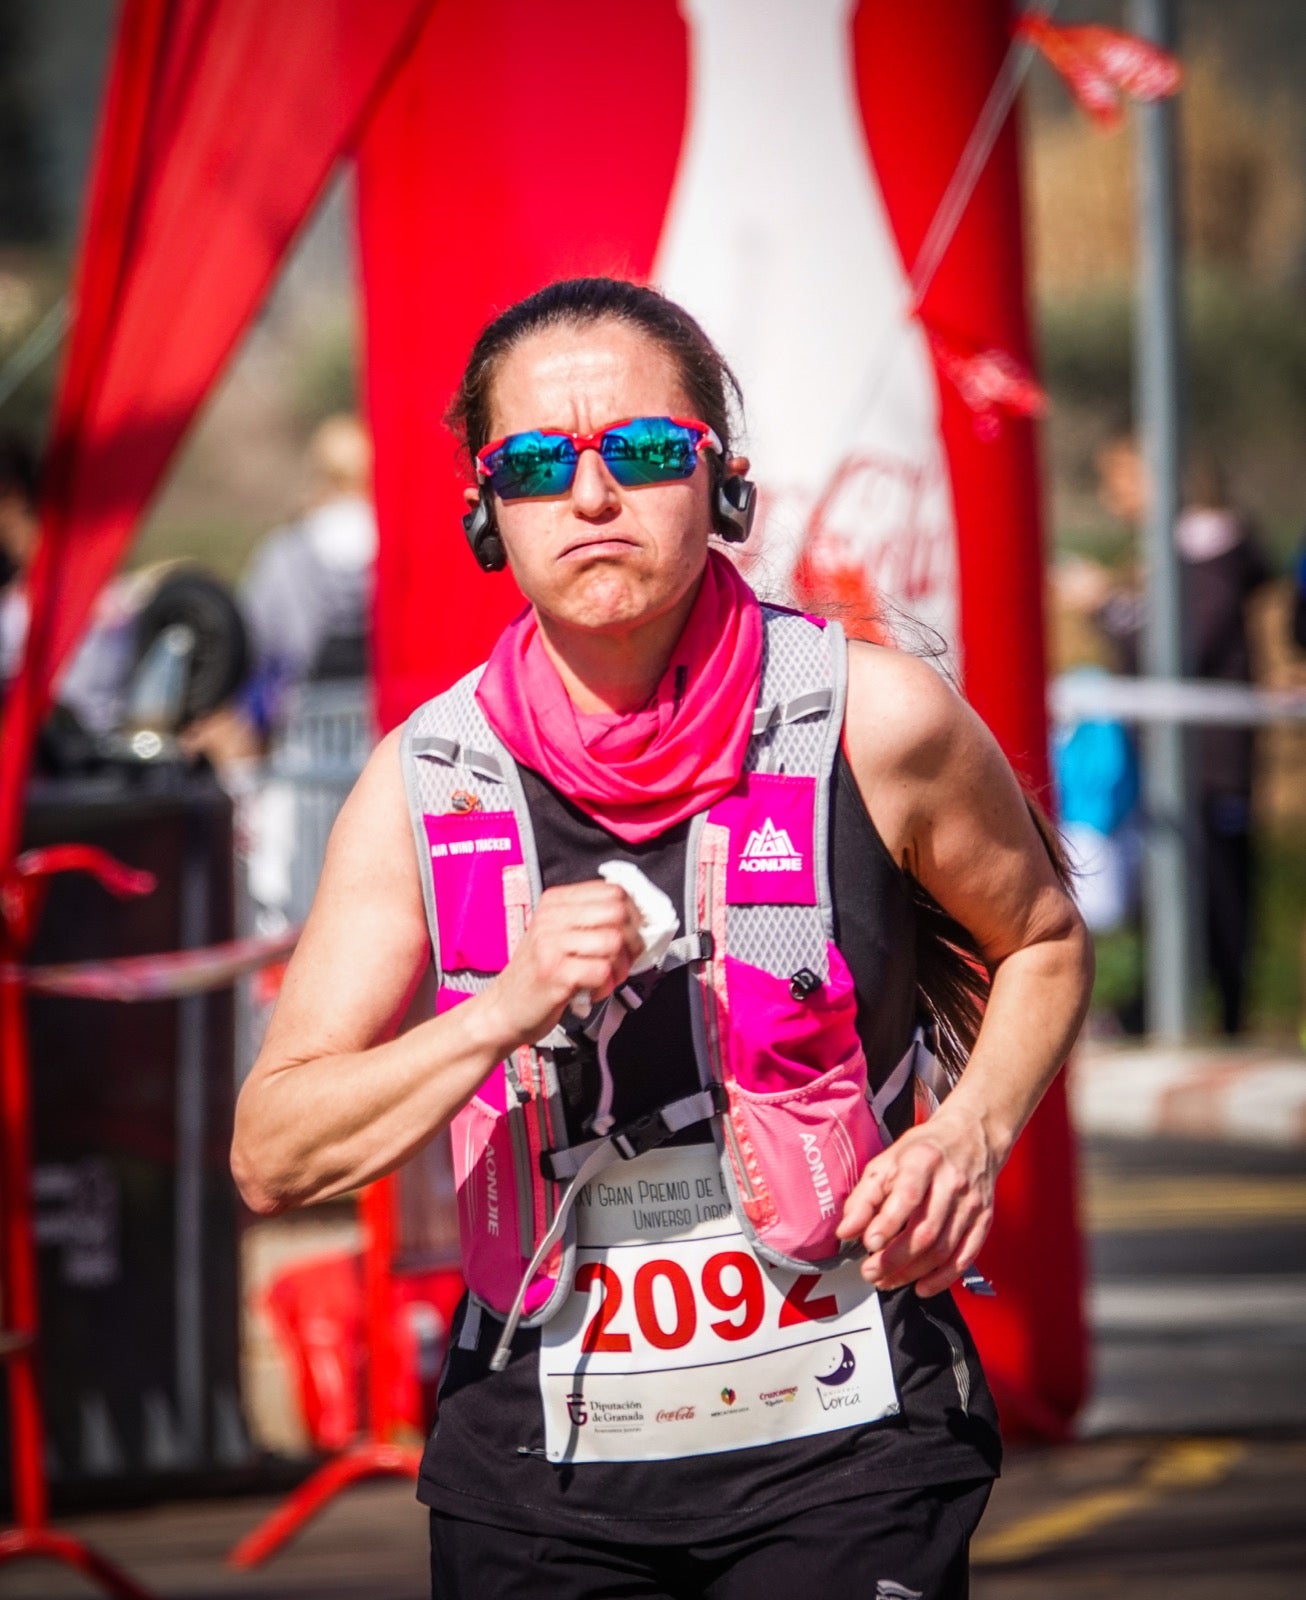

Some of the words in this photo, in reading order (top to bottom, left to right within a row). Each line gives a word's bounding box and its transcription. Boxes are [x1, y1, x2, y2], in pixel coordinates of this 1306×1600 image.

[431, 843, 448, 858] AIR
[448, 840, 474, 855] WIND
[738, 858, 802, 872] AONIJIE
[799, 1133, 836, 1220] AONIJIE
[597, 1182, 633, 1207] GRAN
[638, 1179, 690, 1203] PREMIO
[633, 1207, 691, 1230] UNIVERSO
[575, 1251, 839, 1353] 2092
[590, 1400, 642, 1412] Diputación
[592, 1412, 602, 1422] de
[603, 1411, 644, 1422] Granada
